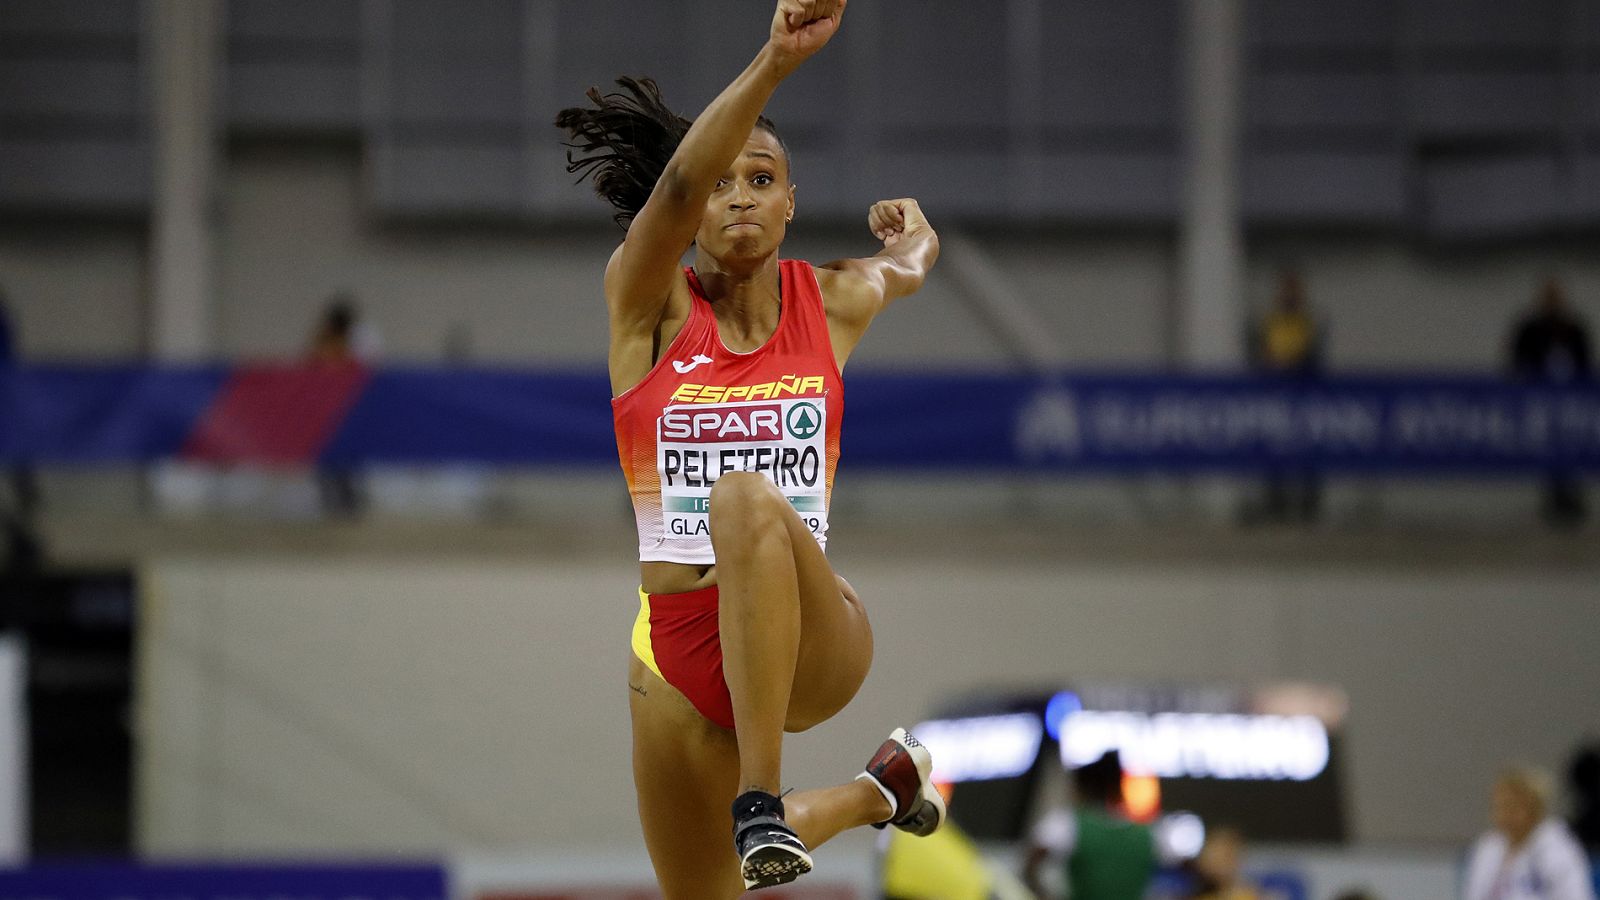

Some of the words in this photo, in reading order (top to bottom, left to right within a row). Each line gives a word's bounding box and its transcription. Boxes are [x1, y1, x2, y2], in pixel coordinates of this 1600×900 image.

[672, 375, 825, 403] ESPAÑA
[664, 410, 780, 438] SPAR
[665, 446, 819, 487] PELETEIRO
